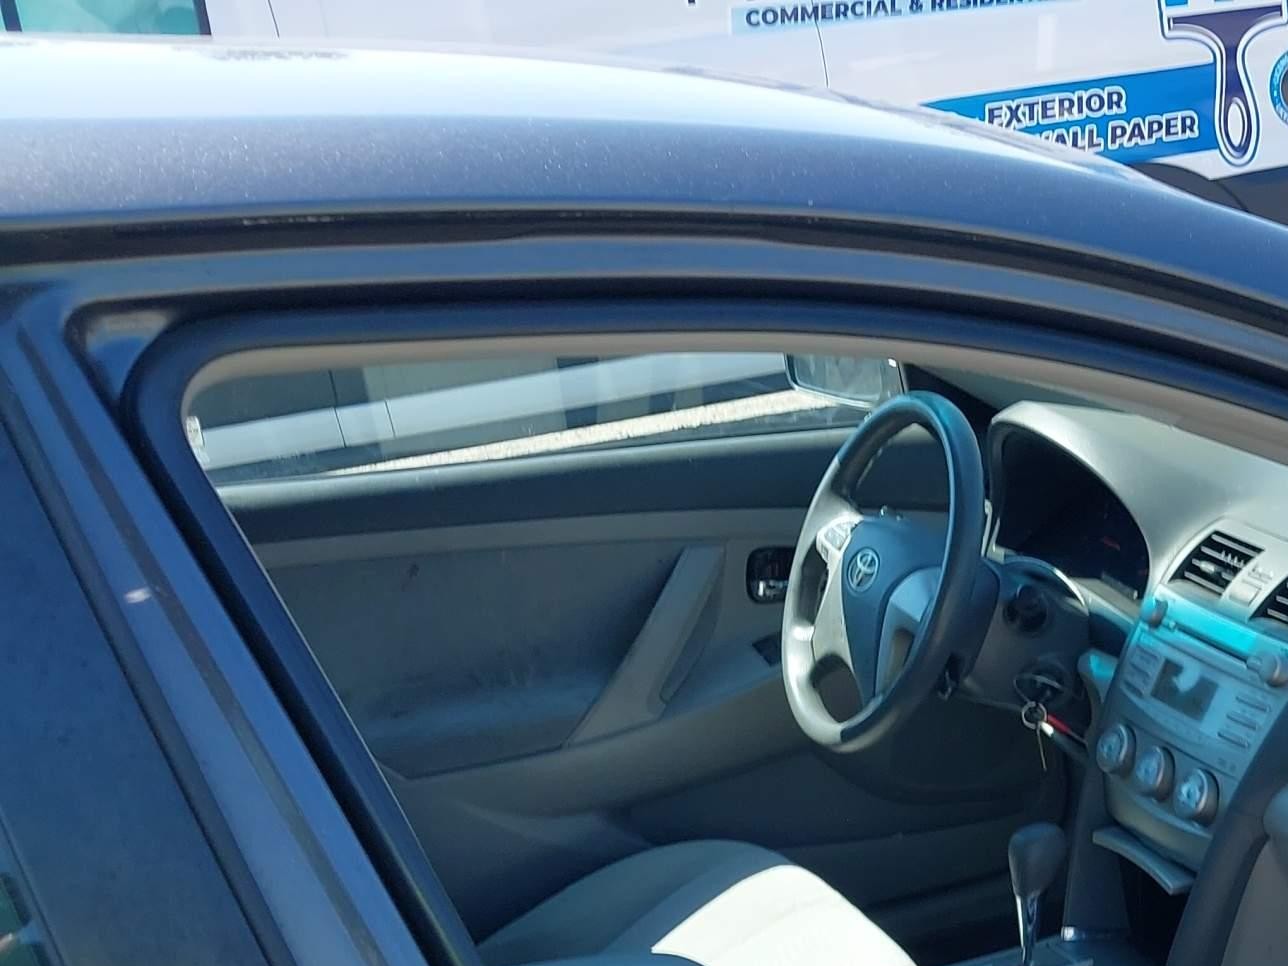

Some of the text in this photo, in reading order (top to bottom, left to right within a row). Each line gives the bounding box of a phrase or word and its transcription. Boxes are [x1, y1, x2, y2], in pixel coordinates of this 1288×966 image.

[745, 0, 902, 27] COMMERCIAL
[906, 0, 924, 14] &
[986, 90, 1125, 128] EXTERIOR
[1110, 114, 1198, 146] PAPER
